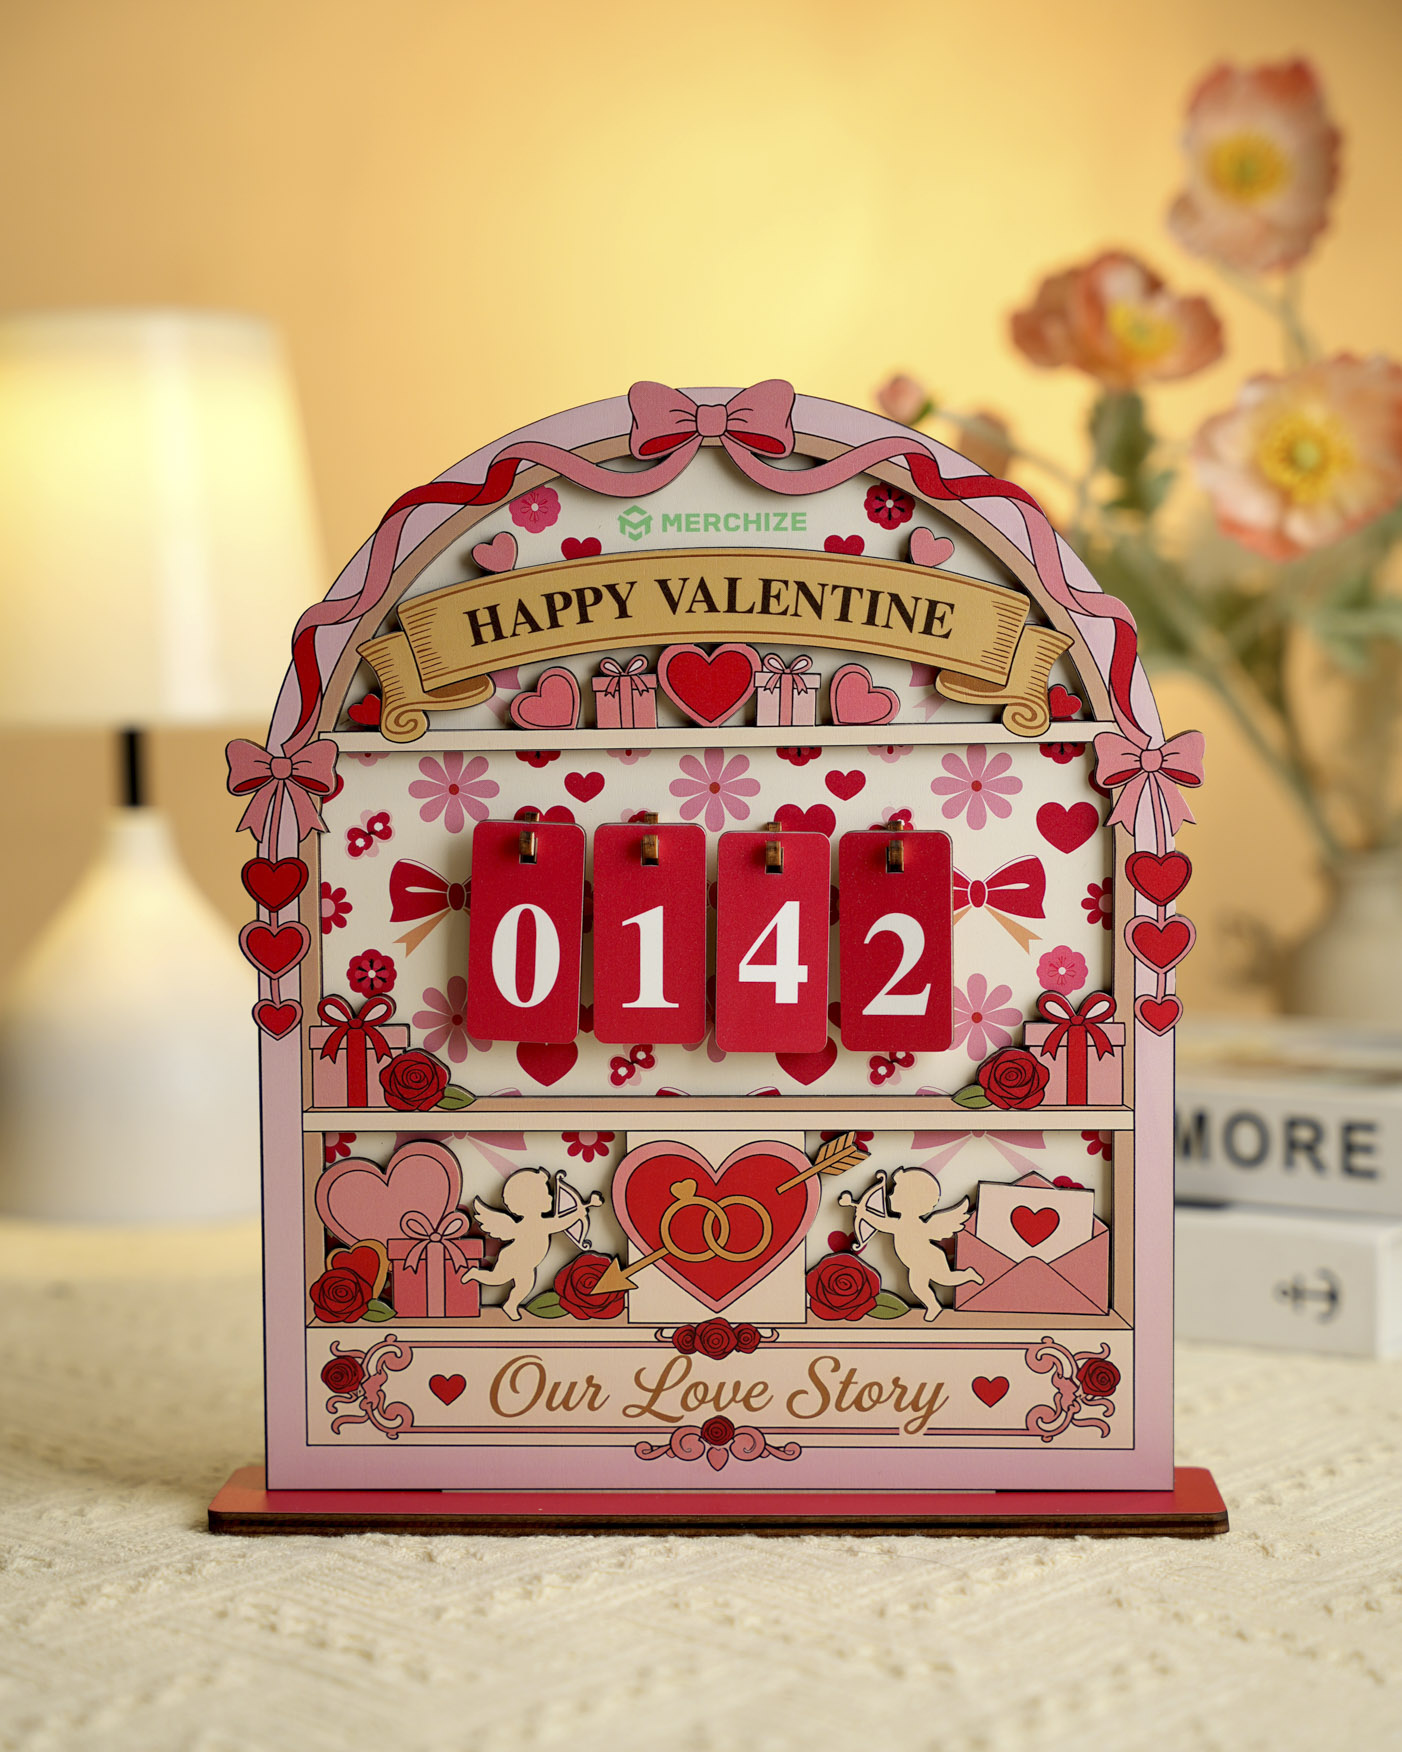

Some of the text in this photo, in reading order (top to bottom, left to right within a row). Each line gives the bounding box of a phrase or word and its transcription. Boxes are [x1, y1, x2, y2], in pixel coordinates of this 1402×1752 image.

[661, 511, 808, 533] MERCHIZE
[462, 576, 956, 648] HAPPY VALENTINE
[1174, 1106, 1381, 1181] MORE
[489, 1354, 950, 1435] Our Love Story
